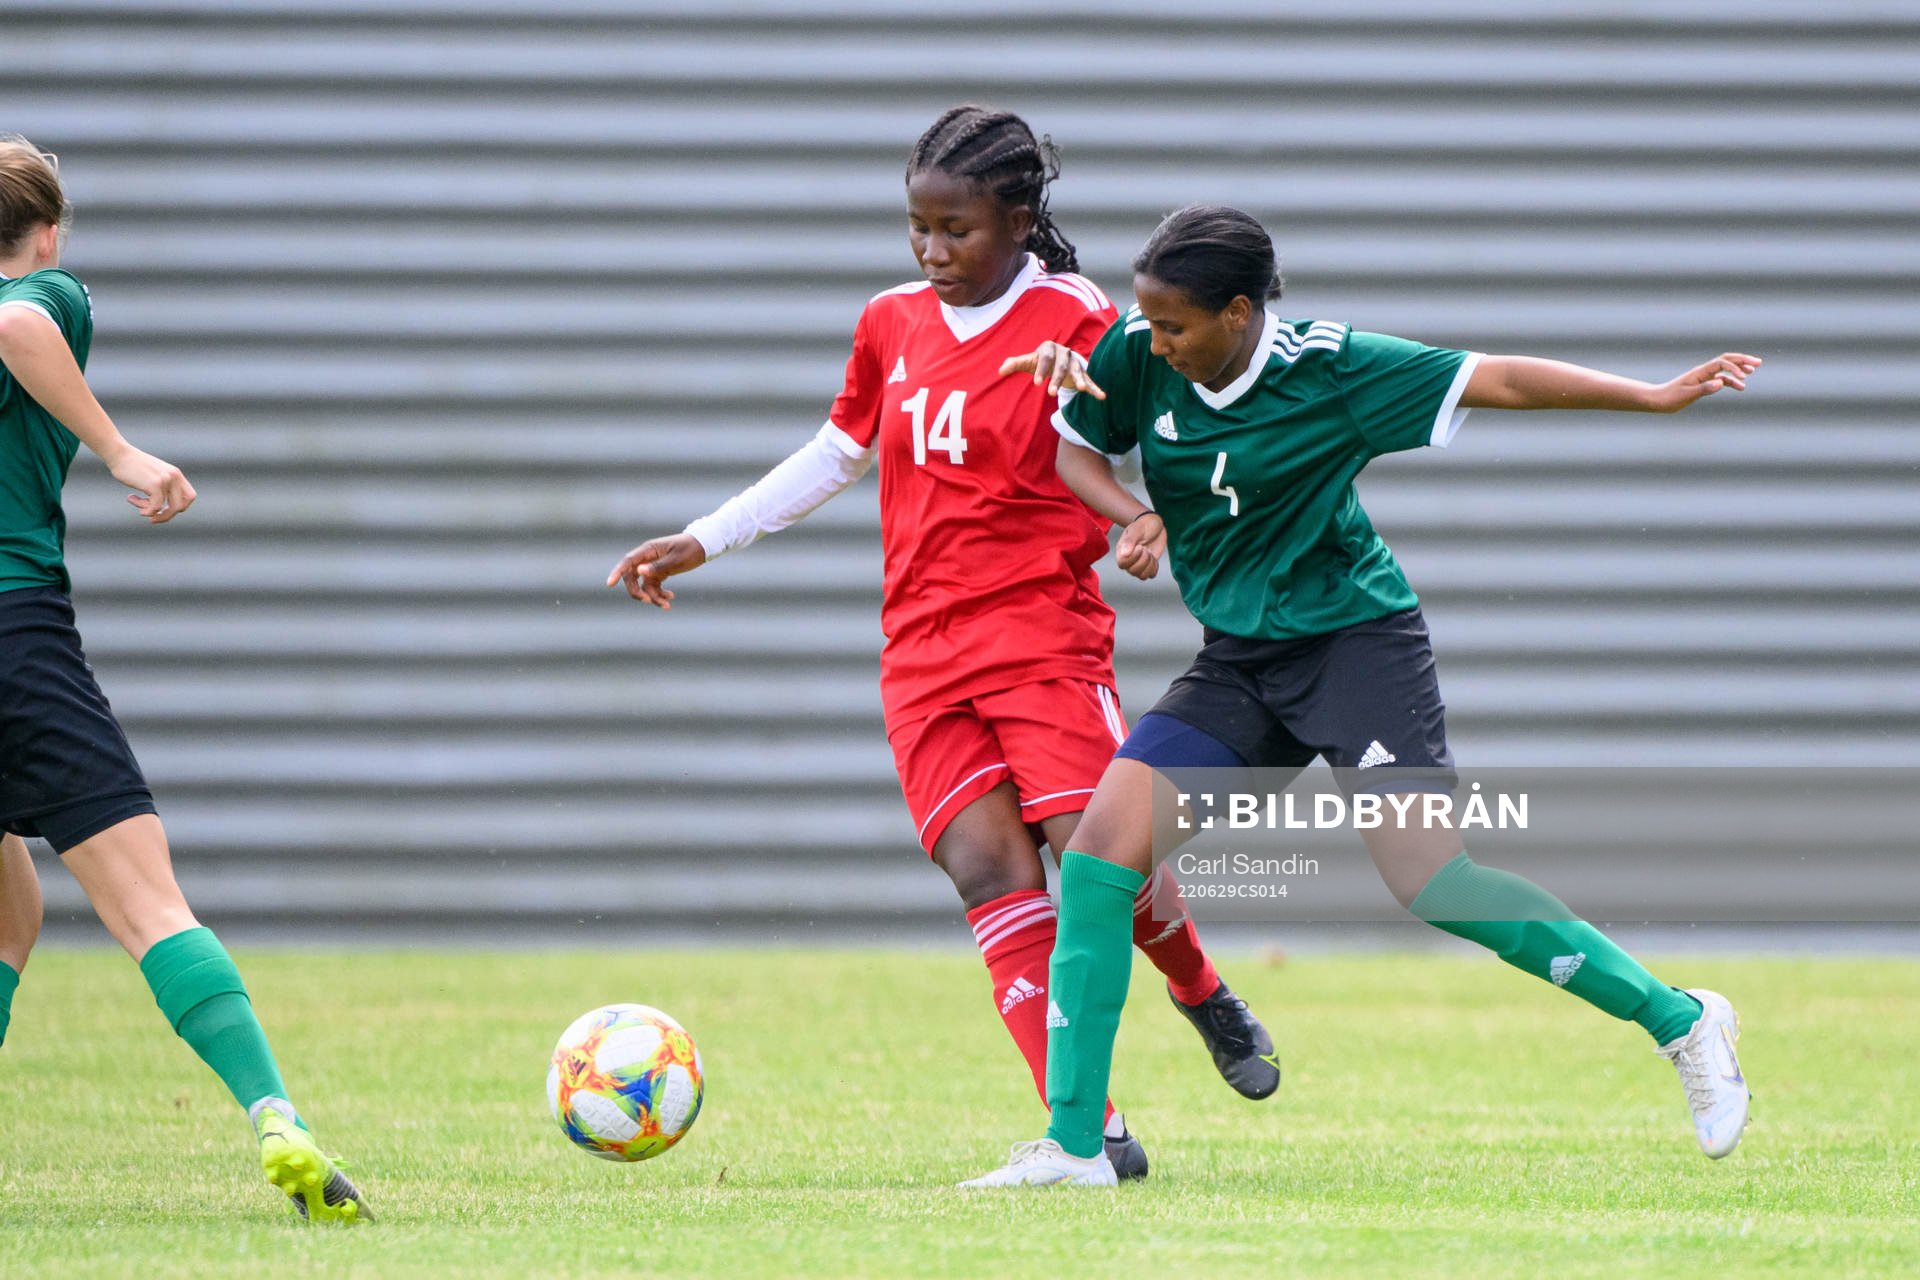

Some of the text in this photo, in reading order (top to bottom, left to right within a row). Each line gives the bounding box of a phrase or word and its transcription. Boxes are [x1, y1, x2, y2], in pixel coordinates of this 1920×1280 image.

[901, 387, 968, 465] 14
[1210, 451, 1239, 517] 4
[1358, 754, 1396, 770] adidas
[1001, 986, 1045, 1015] adidas
